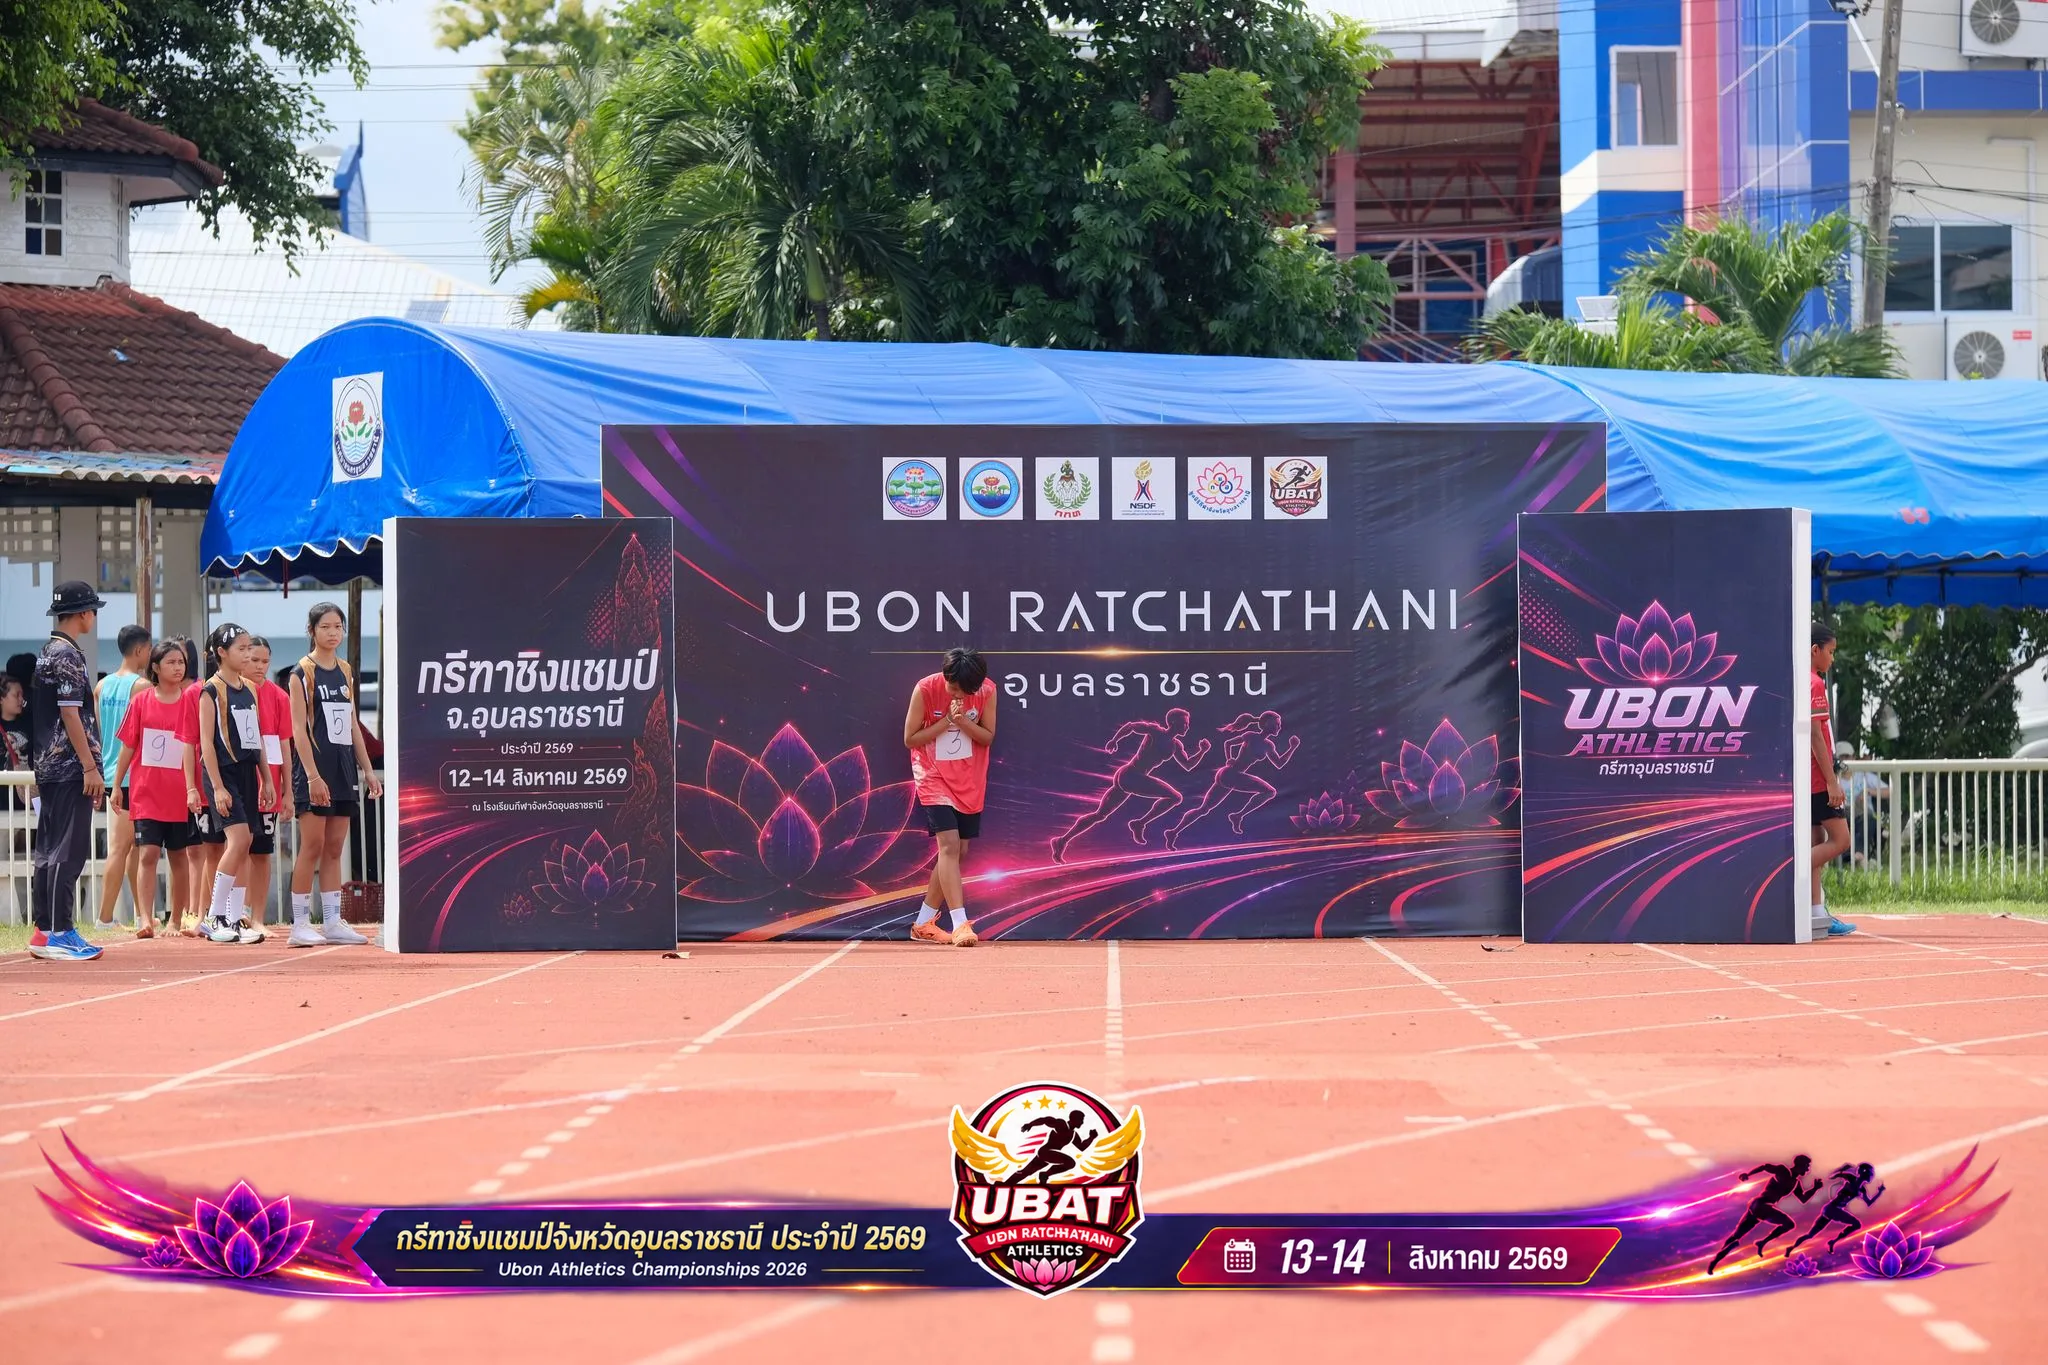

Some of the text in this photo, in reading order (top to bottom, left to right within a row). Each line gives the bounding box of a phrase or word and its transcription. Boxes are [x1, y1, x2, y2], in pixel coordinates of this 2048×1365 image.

[1129, 502, 1156, 510] NSDF
[1274, 488, 1318, 500] UBAT
[766, 588, 1458, 633] UBON RATCHATHANI
[417, 648, 659, 694] กรีฑาชิงแชมป์
[1004, 661, 1269, 709] อุบลราชธานี
[447, 697, 624, 738] จ.อุบลราชธานี
[1563, 685, 1760, 730] UBON
[245, 714, 255, 740] 6
[332, 709, 345, 736] 5
[151, 734, 166, 762] 9
[500, 742, 574, 755] ประจำปี 2569
[946, 729, 962, 755] 3
[1560, 731, 1752, 757] ATHLETICS
[512, 768, 577, 787] สิงหาคม
[583, 768, 628, 786] 2569
[1599, 759, 1715, 778] กรีฑาอุบลราชธานี
[483, 800, 604, 813] โรงเรียนกีฬาจังหวัดอุบลราชธานี
[198, 813, 209, 834] 4
